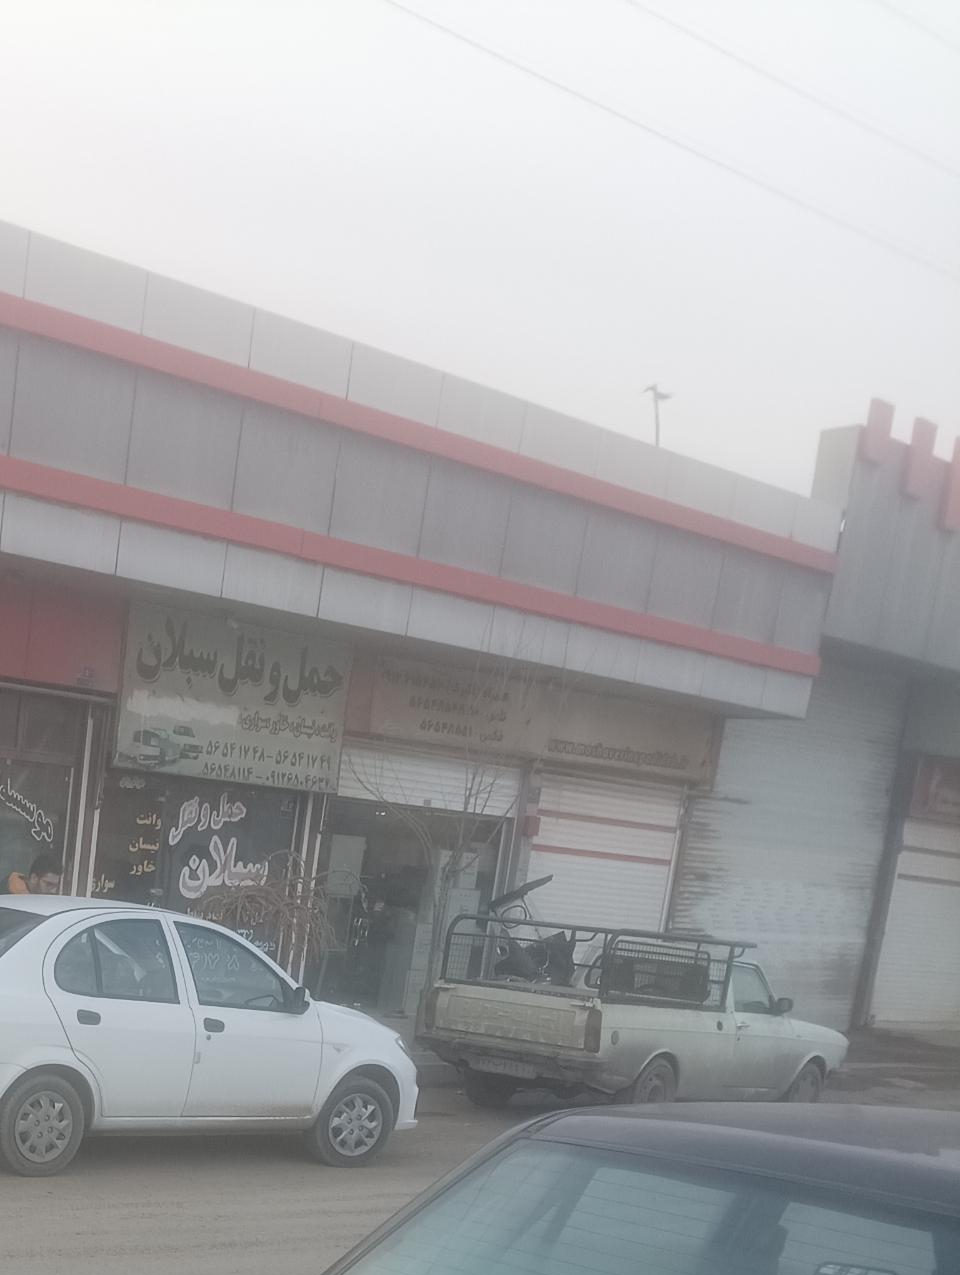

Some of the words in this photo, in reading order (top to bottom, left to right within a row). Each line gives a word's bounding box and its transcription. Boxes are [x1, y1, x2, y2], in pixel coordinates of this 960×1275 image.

[136, 614, 218, 690] سبلان
[217, 630, 266, 698] نقل
[263, 660, 282, 706] و
[282, 645, 344, 708] حمل
[135, 811, 162, 830] وانت
[210, 792, 247, 830] حمل
[128, 838, 160, 853] نیسان
[129, 859, 156, 876] خاور
